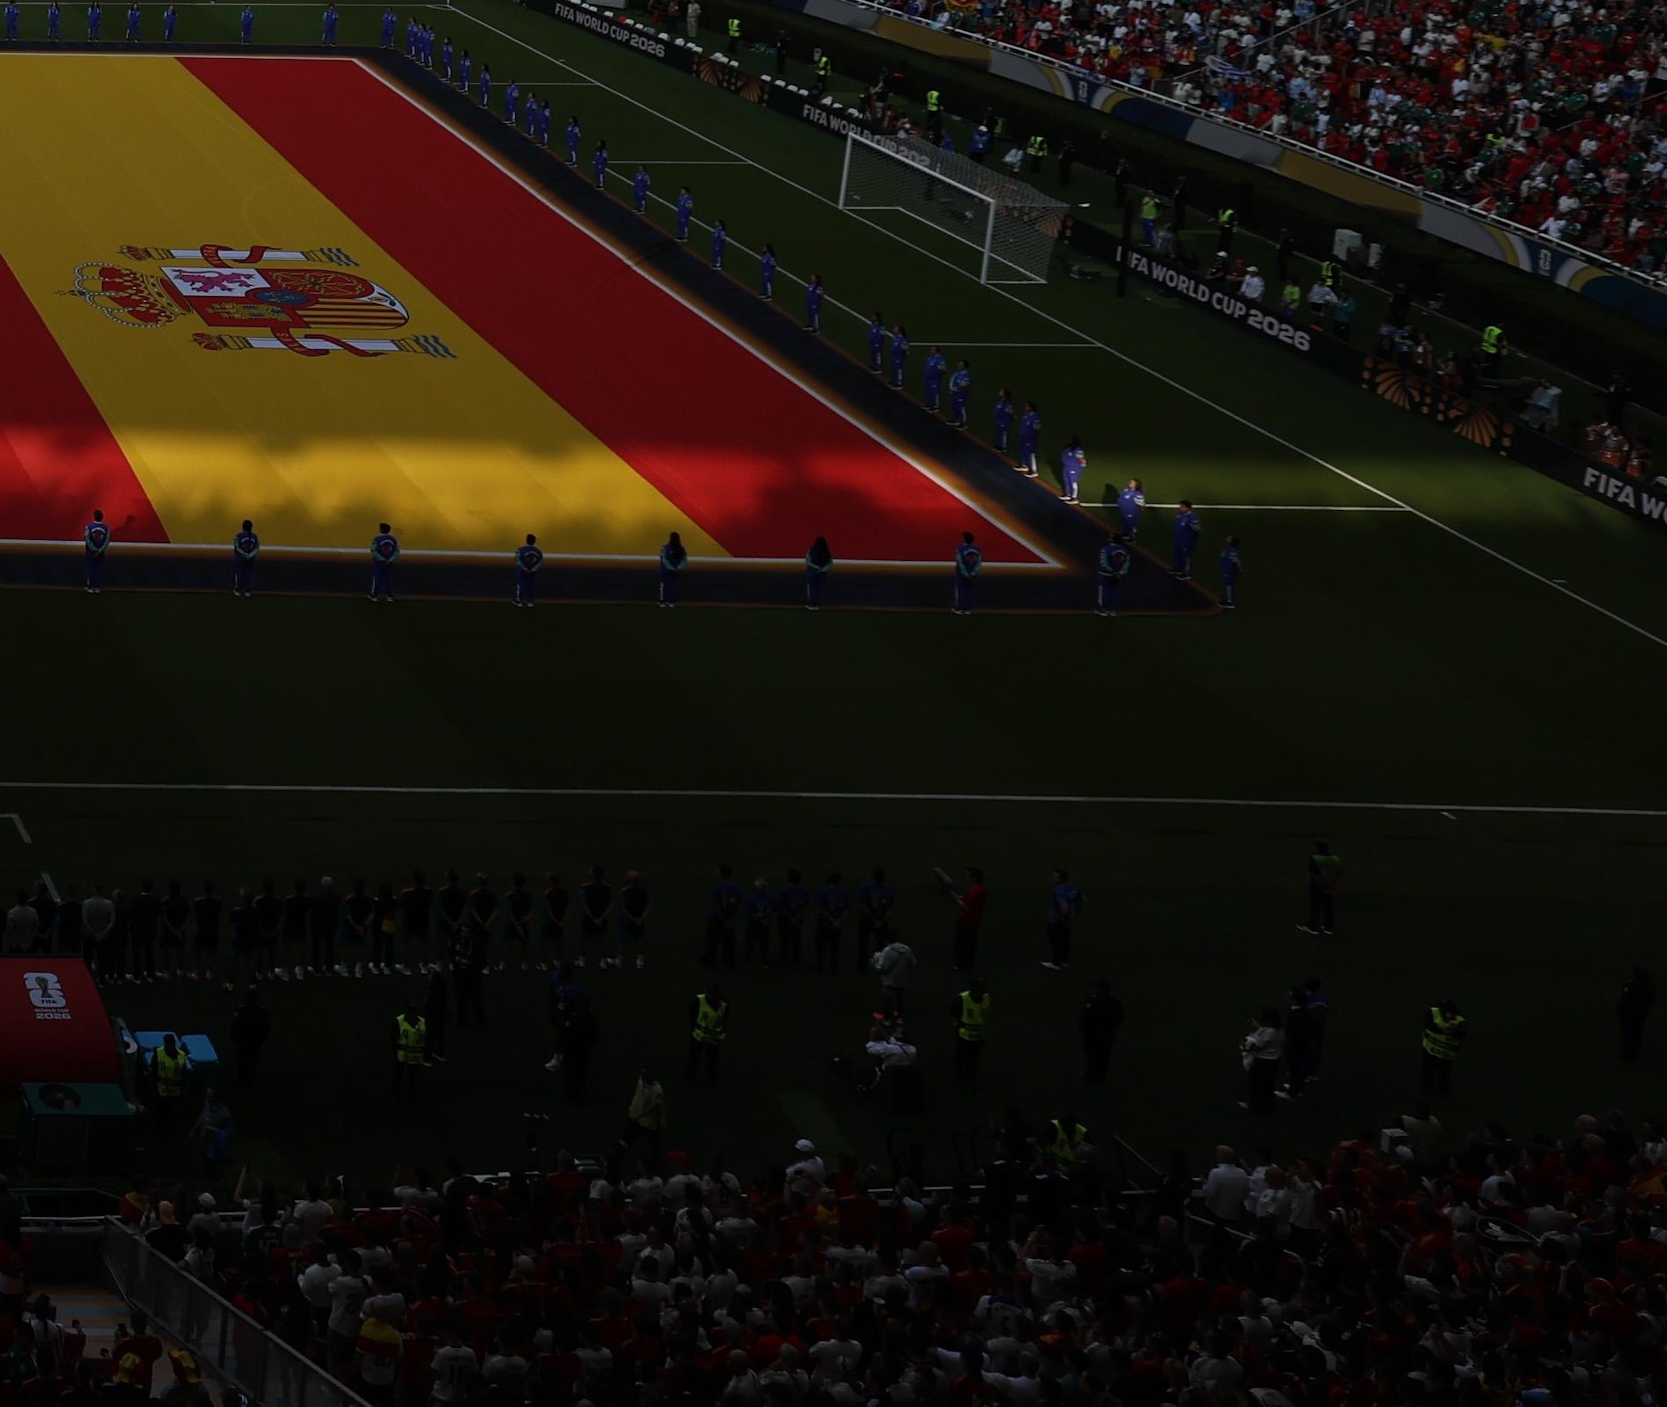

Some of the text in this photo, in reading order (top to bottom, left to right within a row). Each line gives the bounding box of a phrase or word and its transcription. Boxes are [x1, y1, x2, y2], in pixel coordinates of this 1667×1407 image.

[555, 3, 666, 57] FIFA WORLD CUP 2026
[803, 104, 828, 126] FIFA
[1151, 262, 1210, 302] WORLD
[1211, 292, 1247, 319] CUP
[1247, 309, 1311, 351] 2026
[1583, 466, 1635, 508] FIFA
